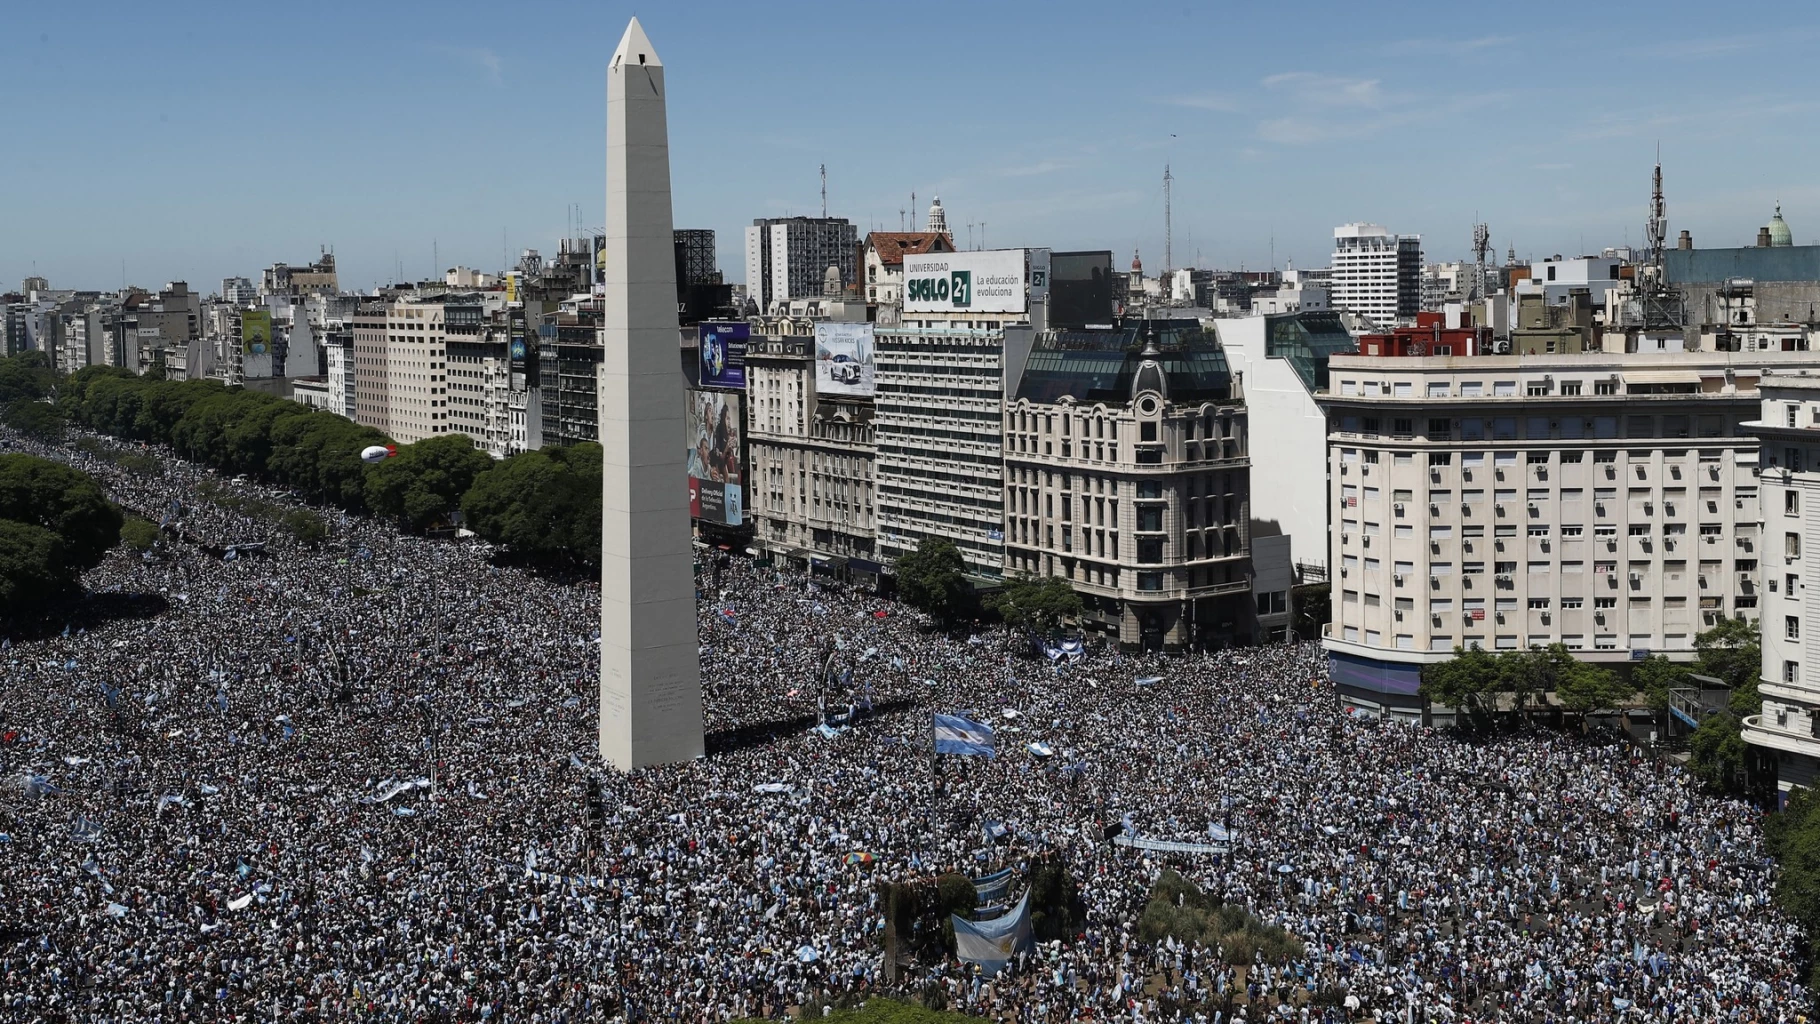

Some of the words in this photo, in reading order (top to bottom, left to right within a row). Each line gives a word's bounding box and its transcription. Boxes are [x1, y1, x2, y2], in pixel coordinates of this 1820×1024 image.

[910, 262, 948, 272] UNIVERSIDAD
[977, 276, 984, 284] La
[986, 274, 1018, 285] educación
[1034, 274, 1044, 286] 21
[908, 278, 949, 302] SIGLO
[954, 277, 967, 302] 21
[977, 286, 1012, 296] evoluciona
